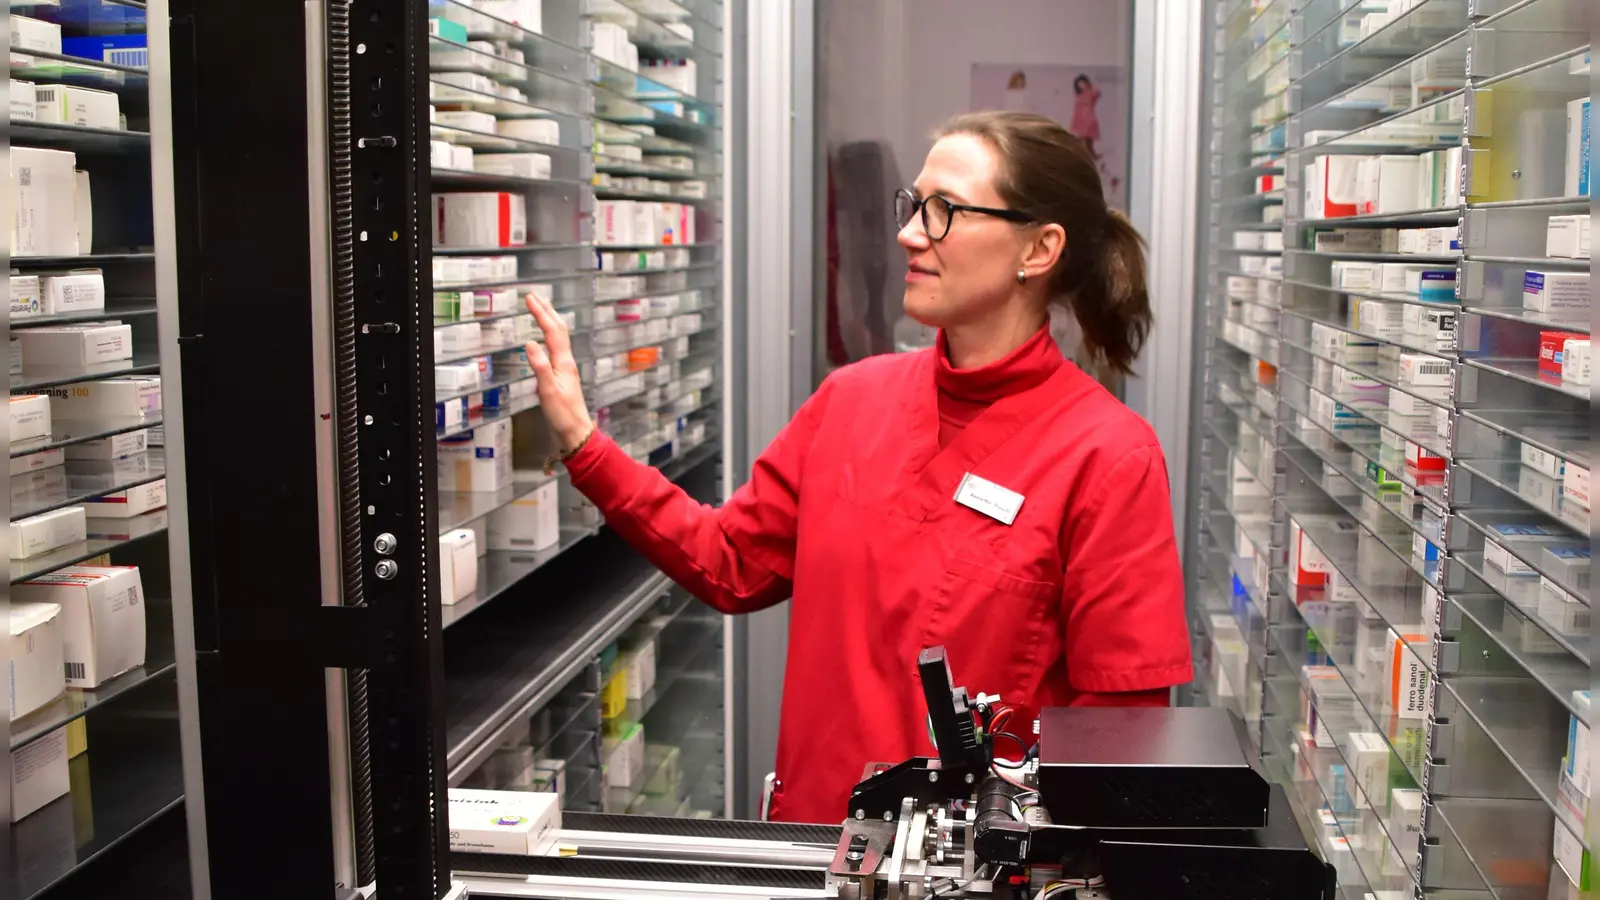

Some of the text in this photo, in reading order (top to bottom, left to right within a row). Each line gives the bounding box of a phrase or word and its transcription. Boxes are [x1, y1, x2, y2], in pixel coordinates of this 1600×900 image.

[71, 388, 90, 397] 100
[1407, 664, 1418, 711] ferro sanol
[1416, 670, 1426, 712] duodenal
